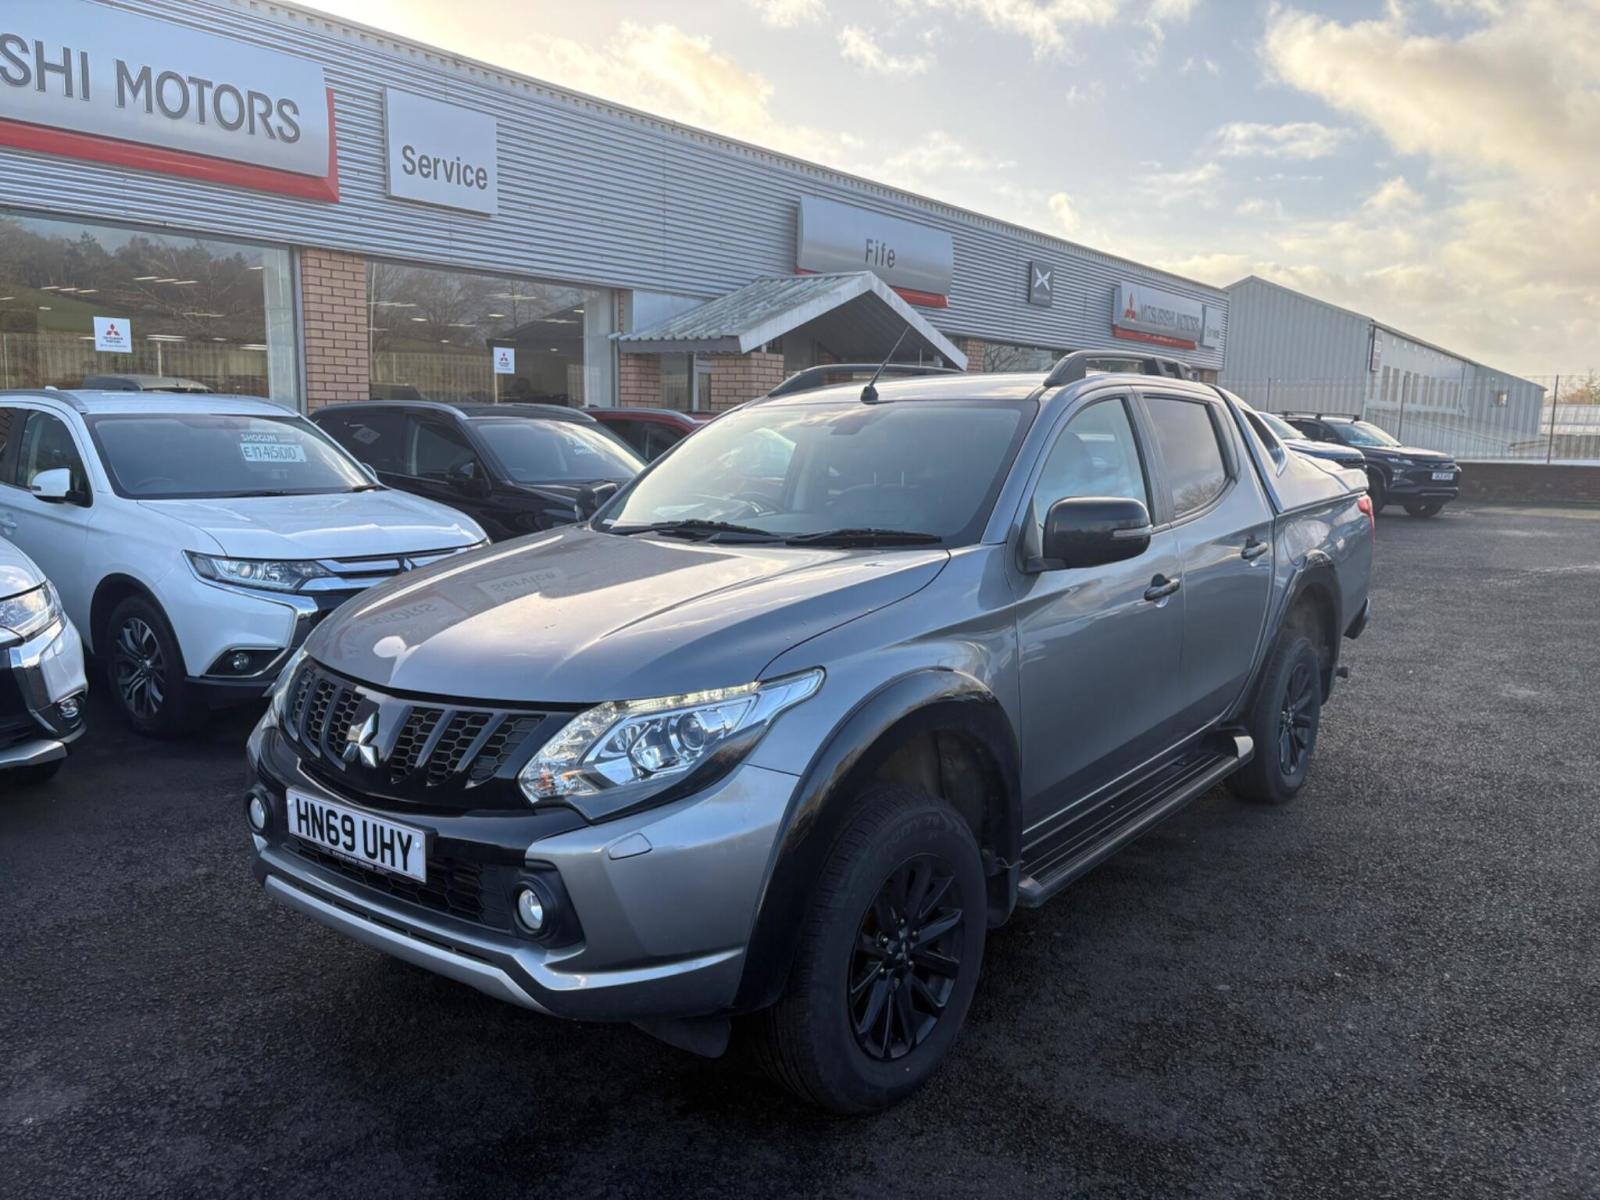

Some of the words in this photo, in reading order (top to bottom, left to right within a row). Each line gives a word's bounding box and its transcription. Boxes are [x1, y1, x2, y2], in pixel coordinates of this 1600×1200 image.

[0, 33, 90, 101] SHI
[115, 58, 301, 145] MOTORS
[402, 144, 488, 190] Service
[865, 238, 896, 269] Fife
[296, 798, 356, 852] HN69
[363, 820, 412, 872] UHY
